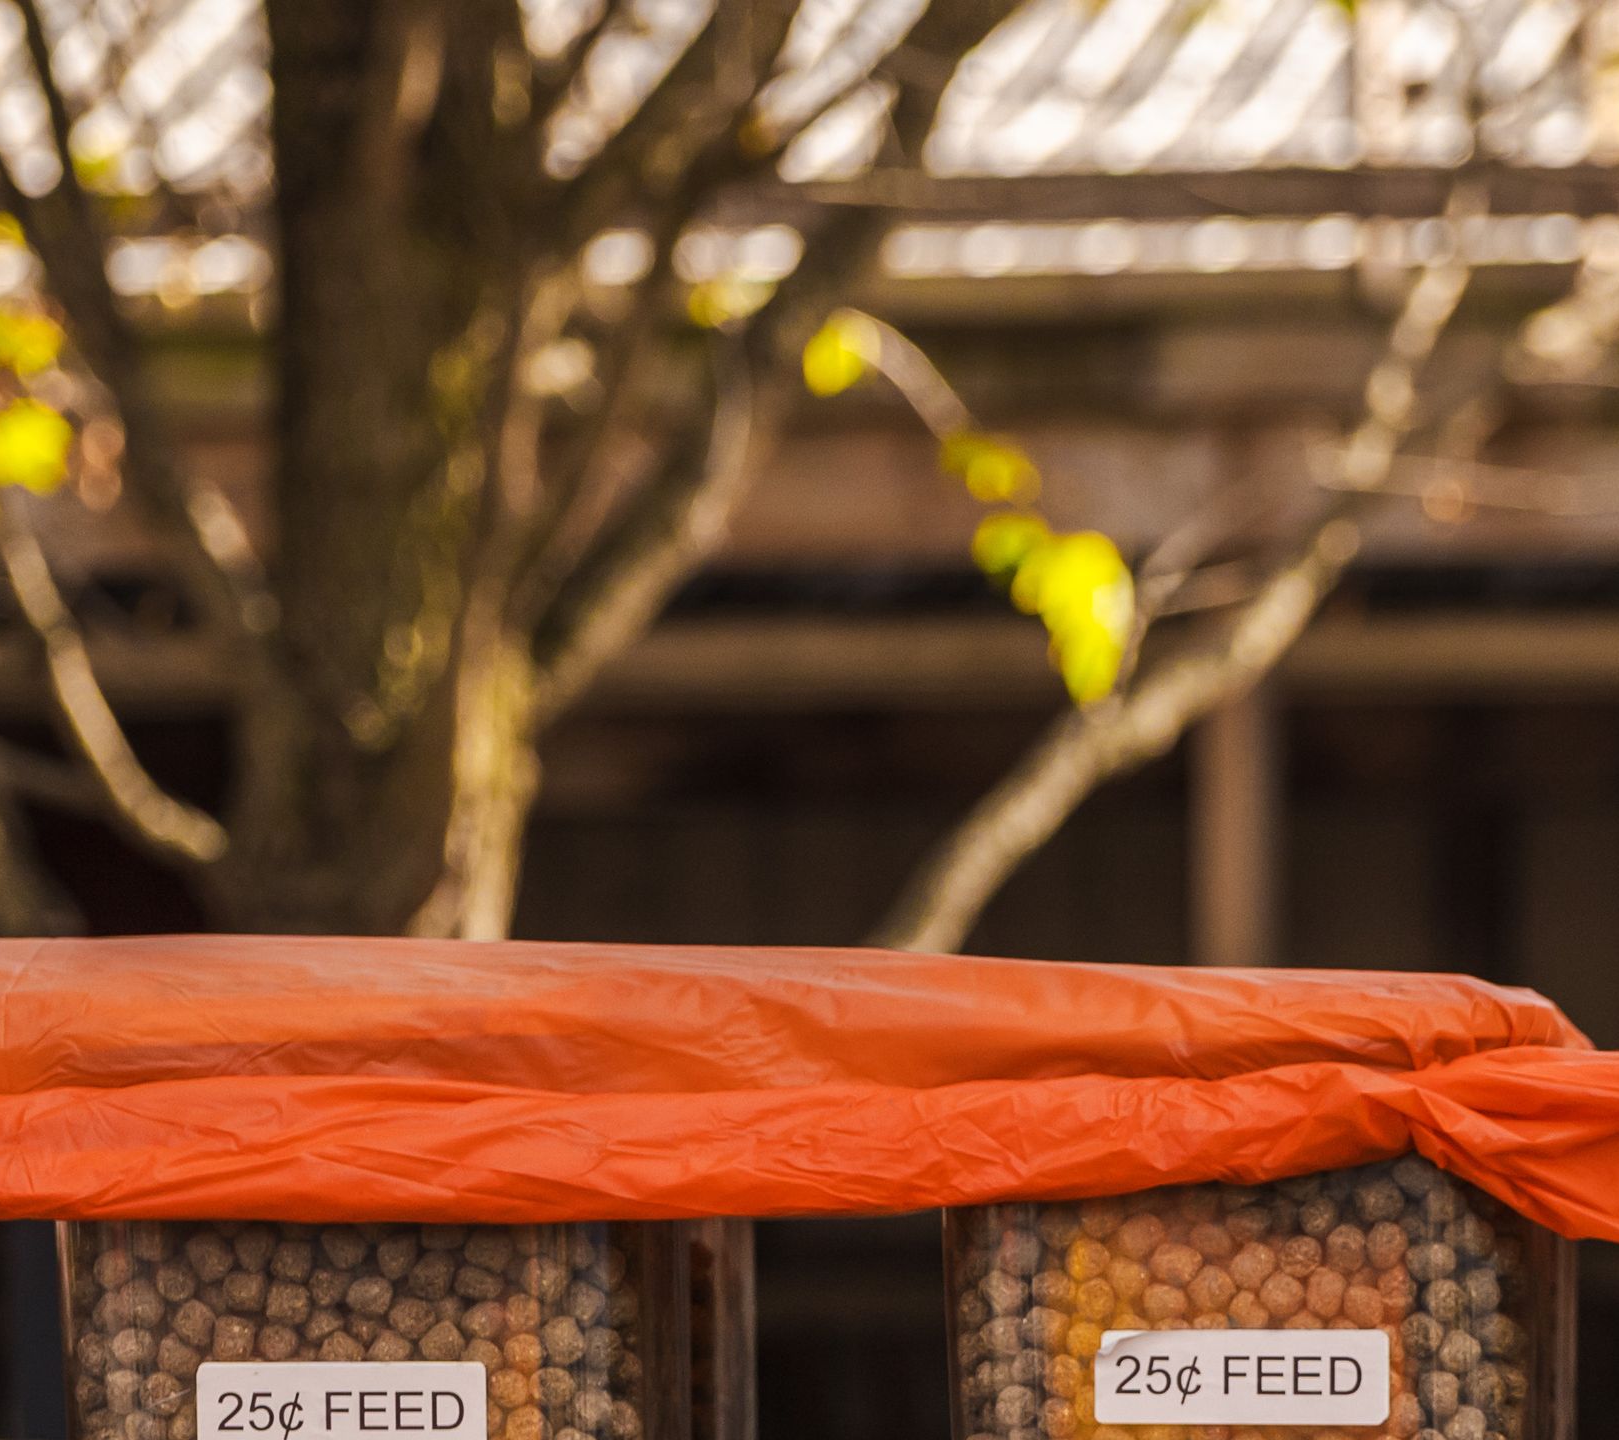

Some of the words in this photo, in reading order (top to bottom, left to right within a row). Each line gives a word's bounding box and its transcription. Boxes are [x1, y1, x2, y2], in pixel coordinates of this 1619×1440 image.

[1114, 1354, 1202, 1406] 25¢
[1223, 1355, 1363, 1396] FEED
[324, 1390, 465, 1431] FEED
